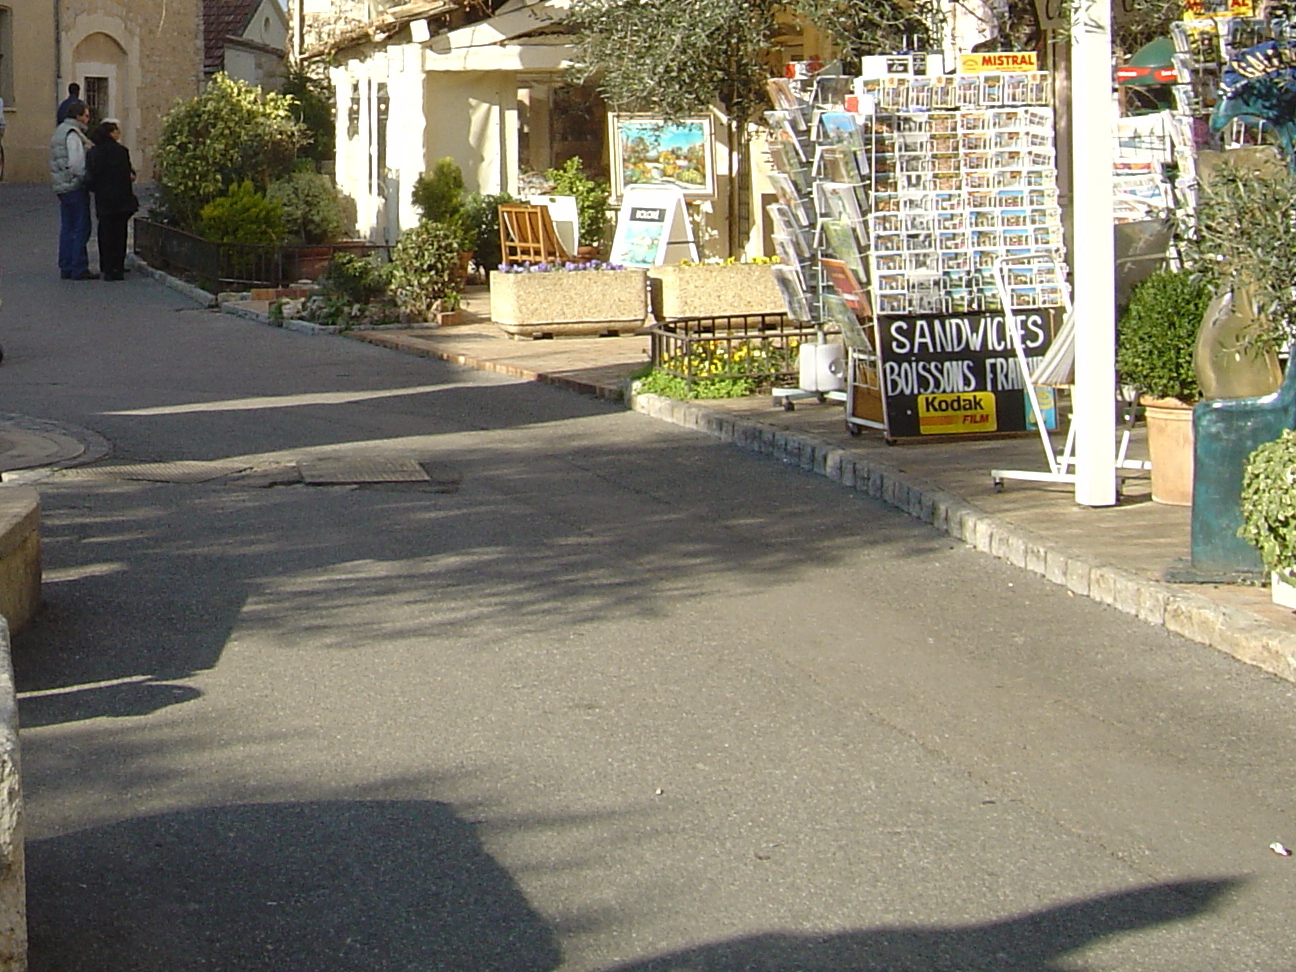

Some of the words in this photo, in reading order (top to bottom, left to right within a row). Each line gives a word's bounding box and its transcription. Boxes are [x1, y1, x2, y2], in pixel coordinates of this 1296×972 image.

[981, 54, 1035, 67] MISTRAL
[884, 357, 976, 396] BOISSONS
[925, 395, 984, 412] Kodak
[962, 414, 989, 424] FILM
